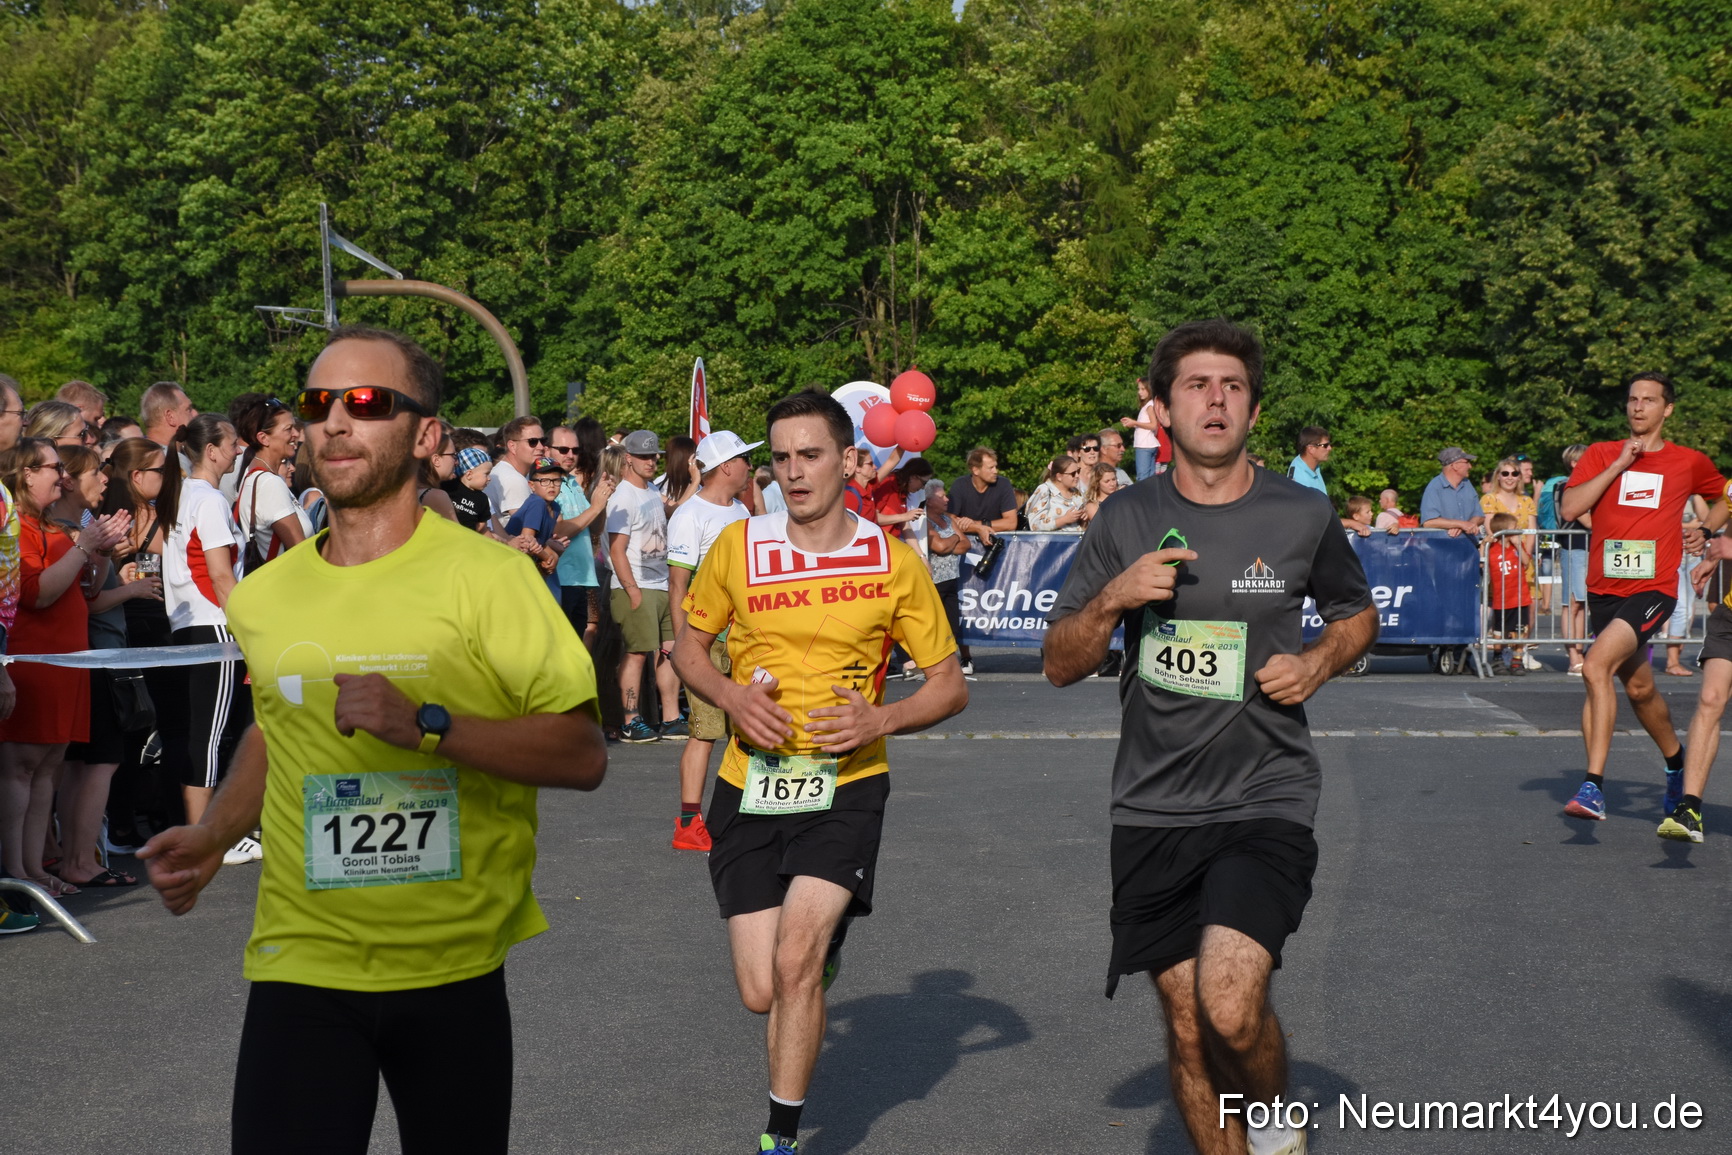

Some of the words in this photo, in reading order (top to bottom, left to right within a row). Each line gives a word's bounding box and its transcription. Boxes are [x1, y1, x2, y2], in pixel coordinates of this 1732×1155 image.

[1613, 553, 1641, 568] 511
[1231, 579, 1286, 588] BURKHARDT
[747, 589, 812, 613] MAX
[821, 581, 890, 604] BÖGL
[335, 654, 367, 662] Kliniken
[368, 654, 382, 662] des
[383, 652, 428, 661] Landkreises
[1155, 645, 1218, 677] 403
[359, 663, 398, 672] Neumarkt
[1154, 667, 1178, 680] Böhm
[1179, 675, 1221, 686] Sebastian
[1162, 677, 1191, 688] Burkhardt
[758, 776, 824, 801] 1673
[326, 794, 384, 808] firmenlauf
[420, 798, 448, 809] 2019
[755, 798, 791, 807] Schönherr
[323, 810, 438, 855] 1227
[342, 856, 378, 867] Goroll
[381, 853, 421, 865] Tobias
[344, 867, 379, 876] Klinikum
[380, 865, 419, 874] Neumarkt
